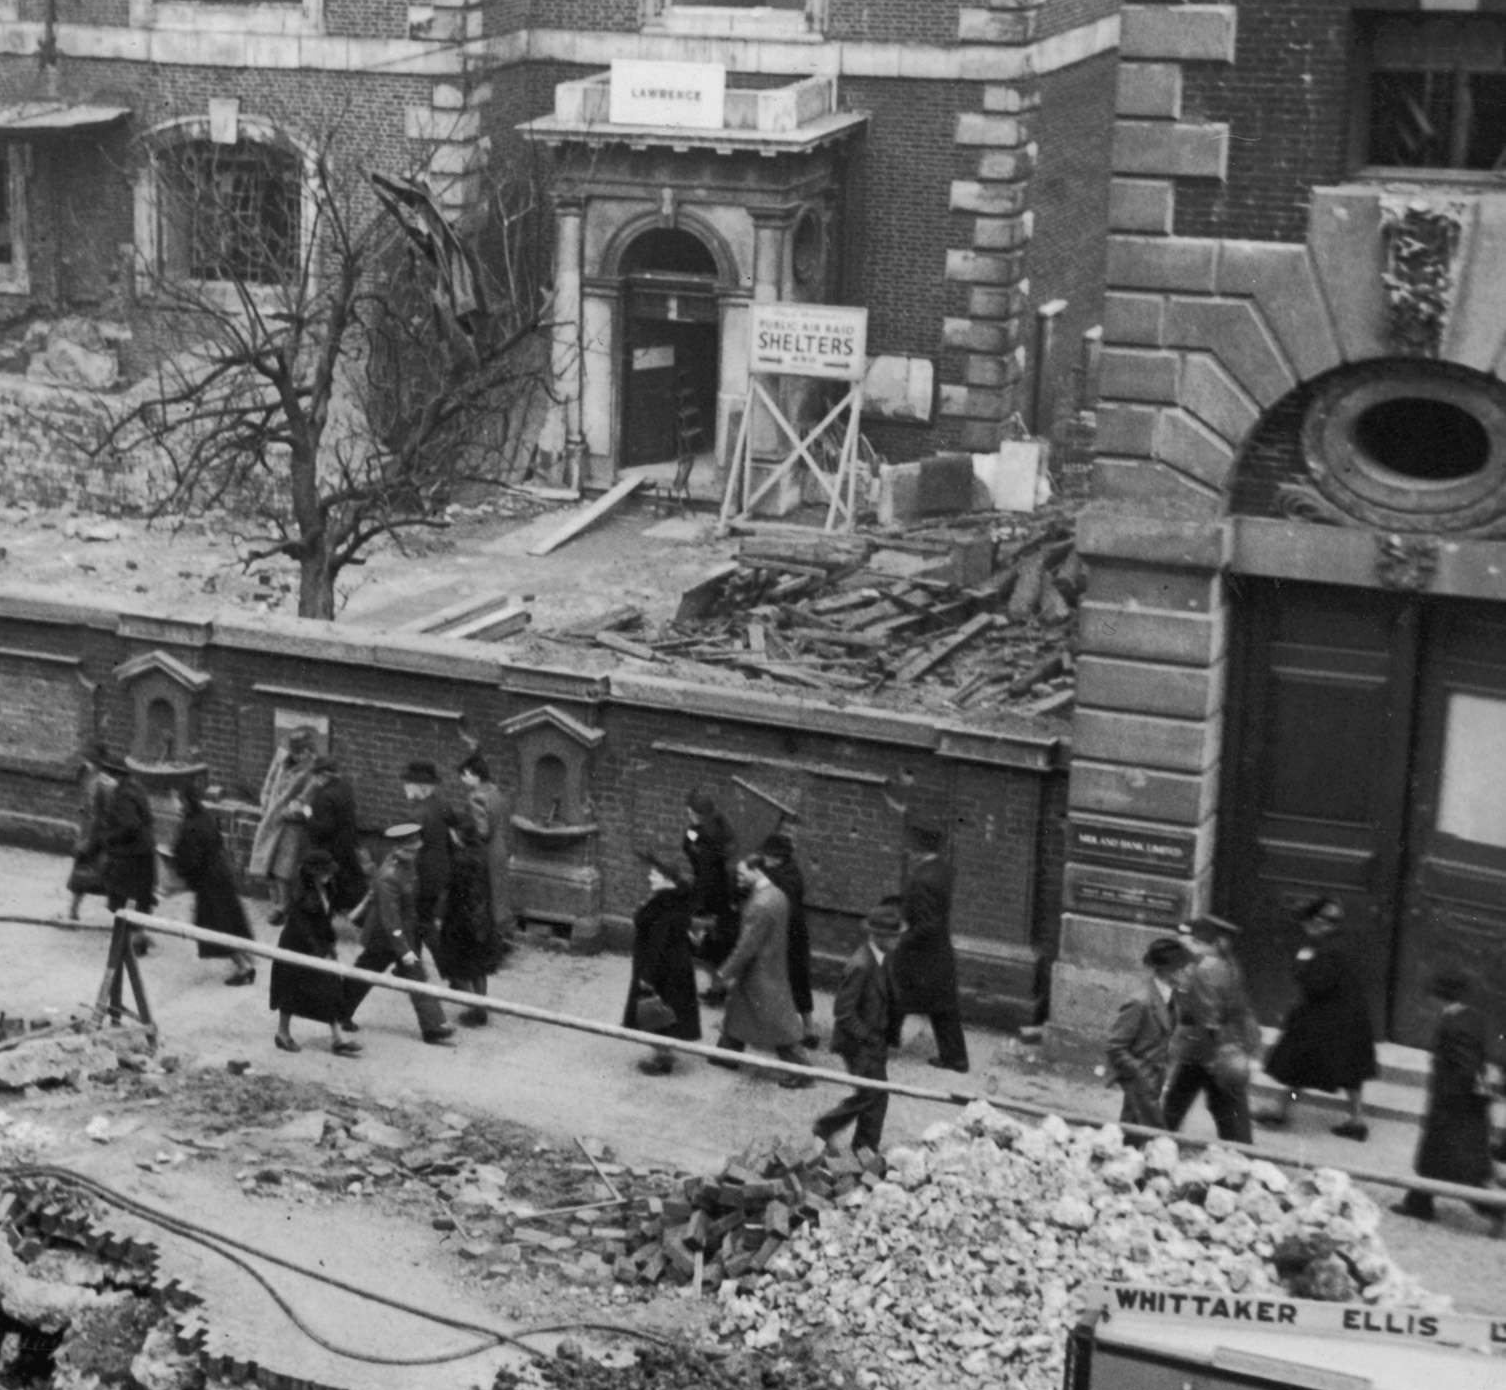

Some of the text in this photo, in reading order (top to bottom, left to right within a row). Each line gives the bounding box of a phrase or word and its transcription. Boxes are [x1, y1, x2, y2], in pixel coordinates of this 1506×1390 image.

[630, 87, 702, 102] LAWRENCE
[759, 319, 855, 336] PUBLIC AIR RAID
[758, 331, 854, 356] SHELTERS
[1116, 1288, 1297, 1324] WHITTAKER
[1343, 1309, 1438, 1337] ELLIS
